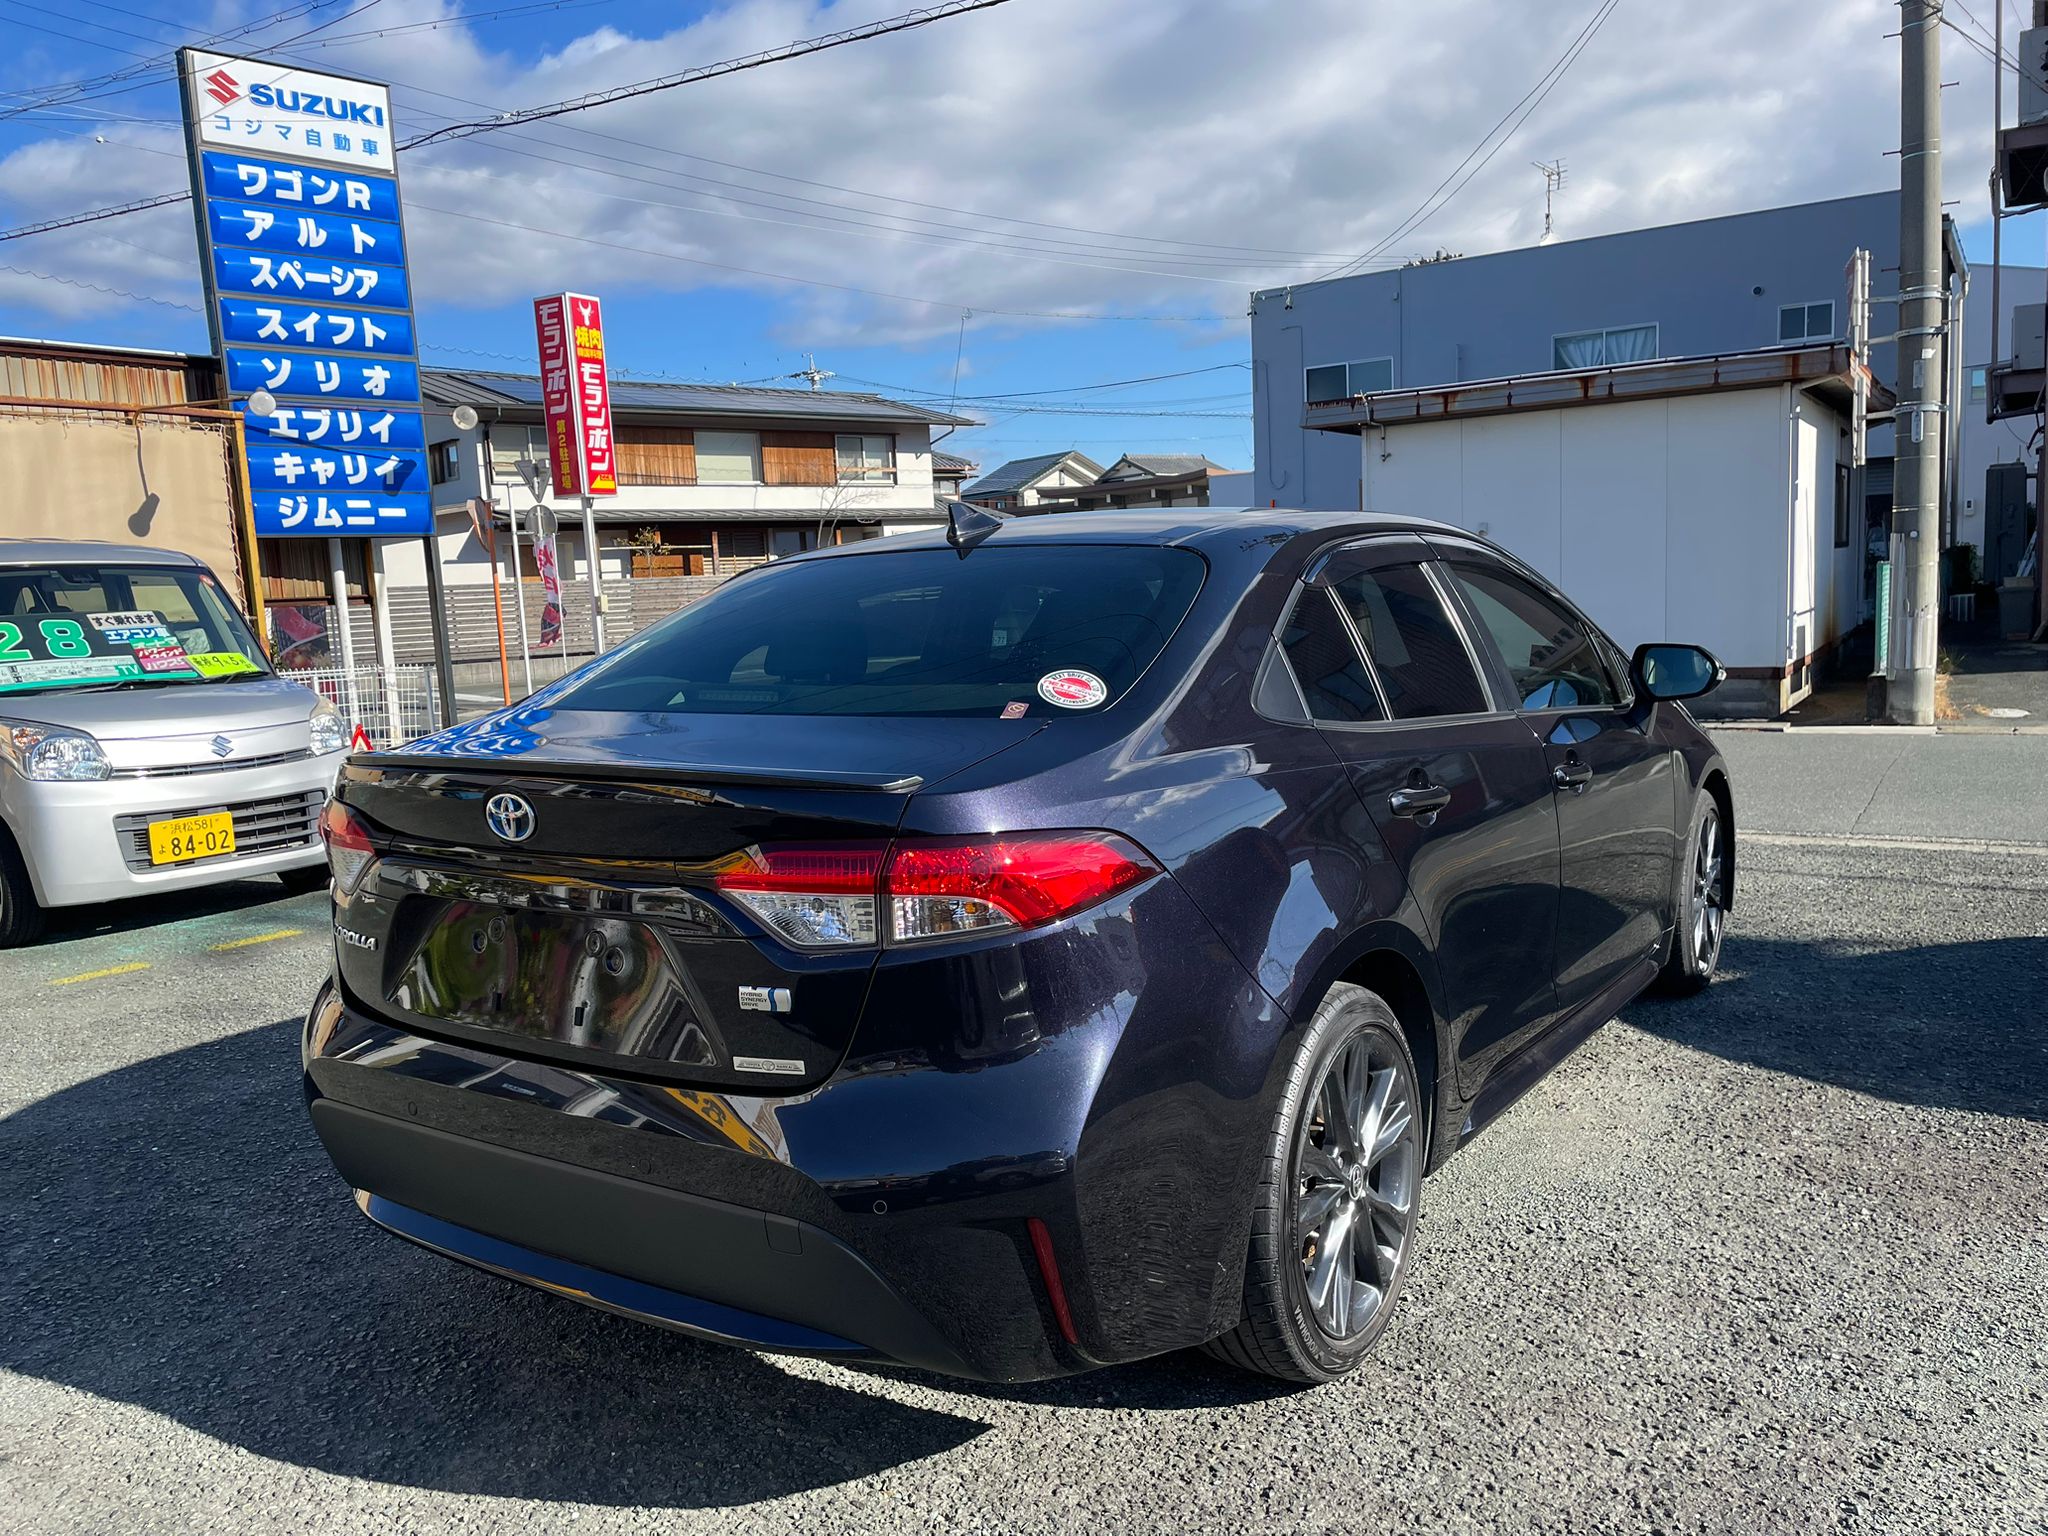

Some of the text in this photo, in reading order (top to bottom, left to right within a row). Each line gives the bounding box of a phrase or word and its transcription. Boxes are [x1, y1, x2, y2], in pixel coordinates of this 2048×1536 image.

[249, 83, 385, 128] SUZUKI
[214, 114, 379, 157] コジマ自動車
[237, 163, 371, 211] ワゴンR
[242, 209, 376, 254] アルト
[249, 256, 378, 299] スペーシア
[255, 307, 387, 348] スイフト
[261, 357, 391, 396] ソリオ
[539, 302, 568, 415] モランボン
[580, 362, 610, 471] モランボン
[278, 496, 407, 528] ジムニー
[171, 829, 230, 856] 84-02
